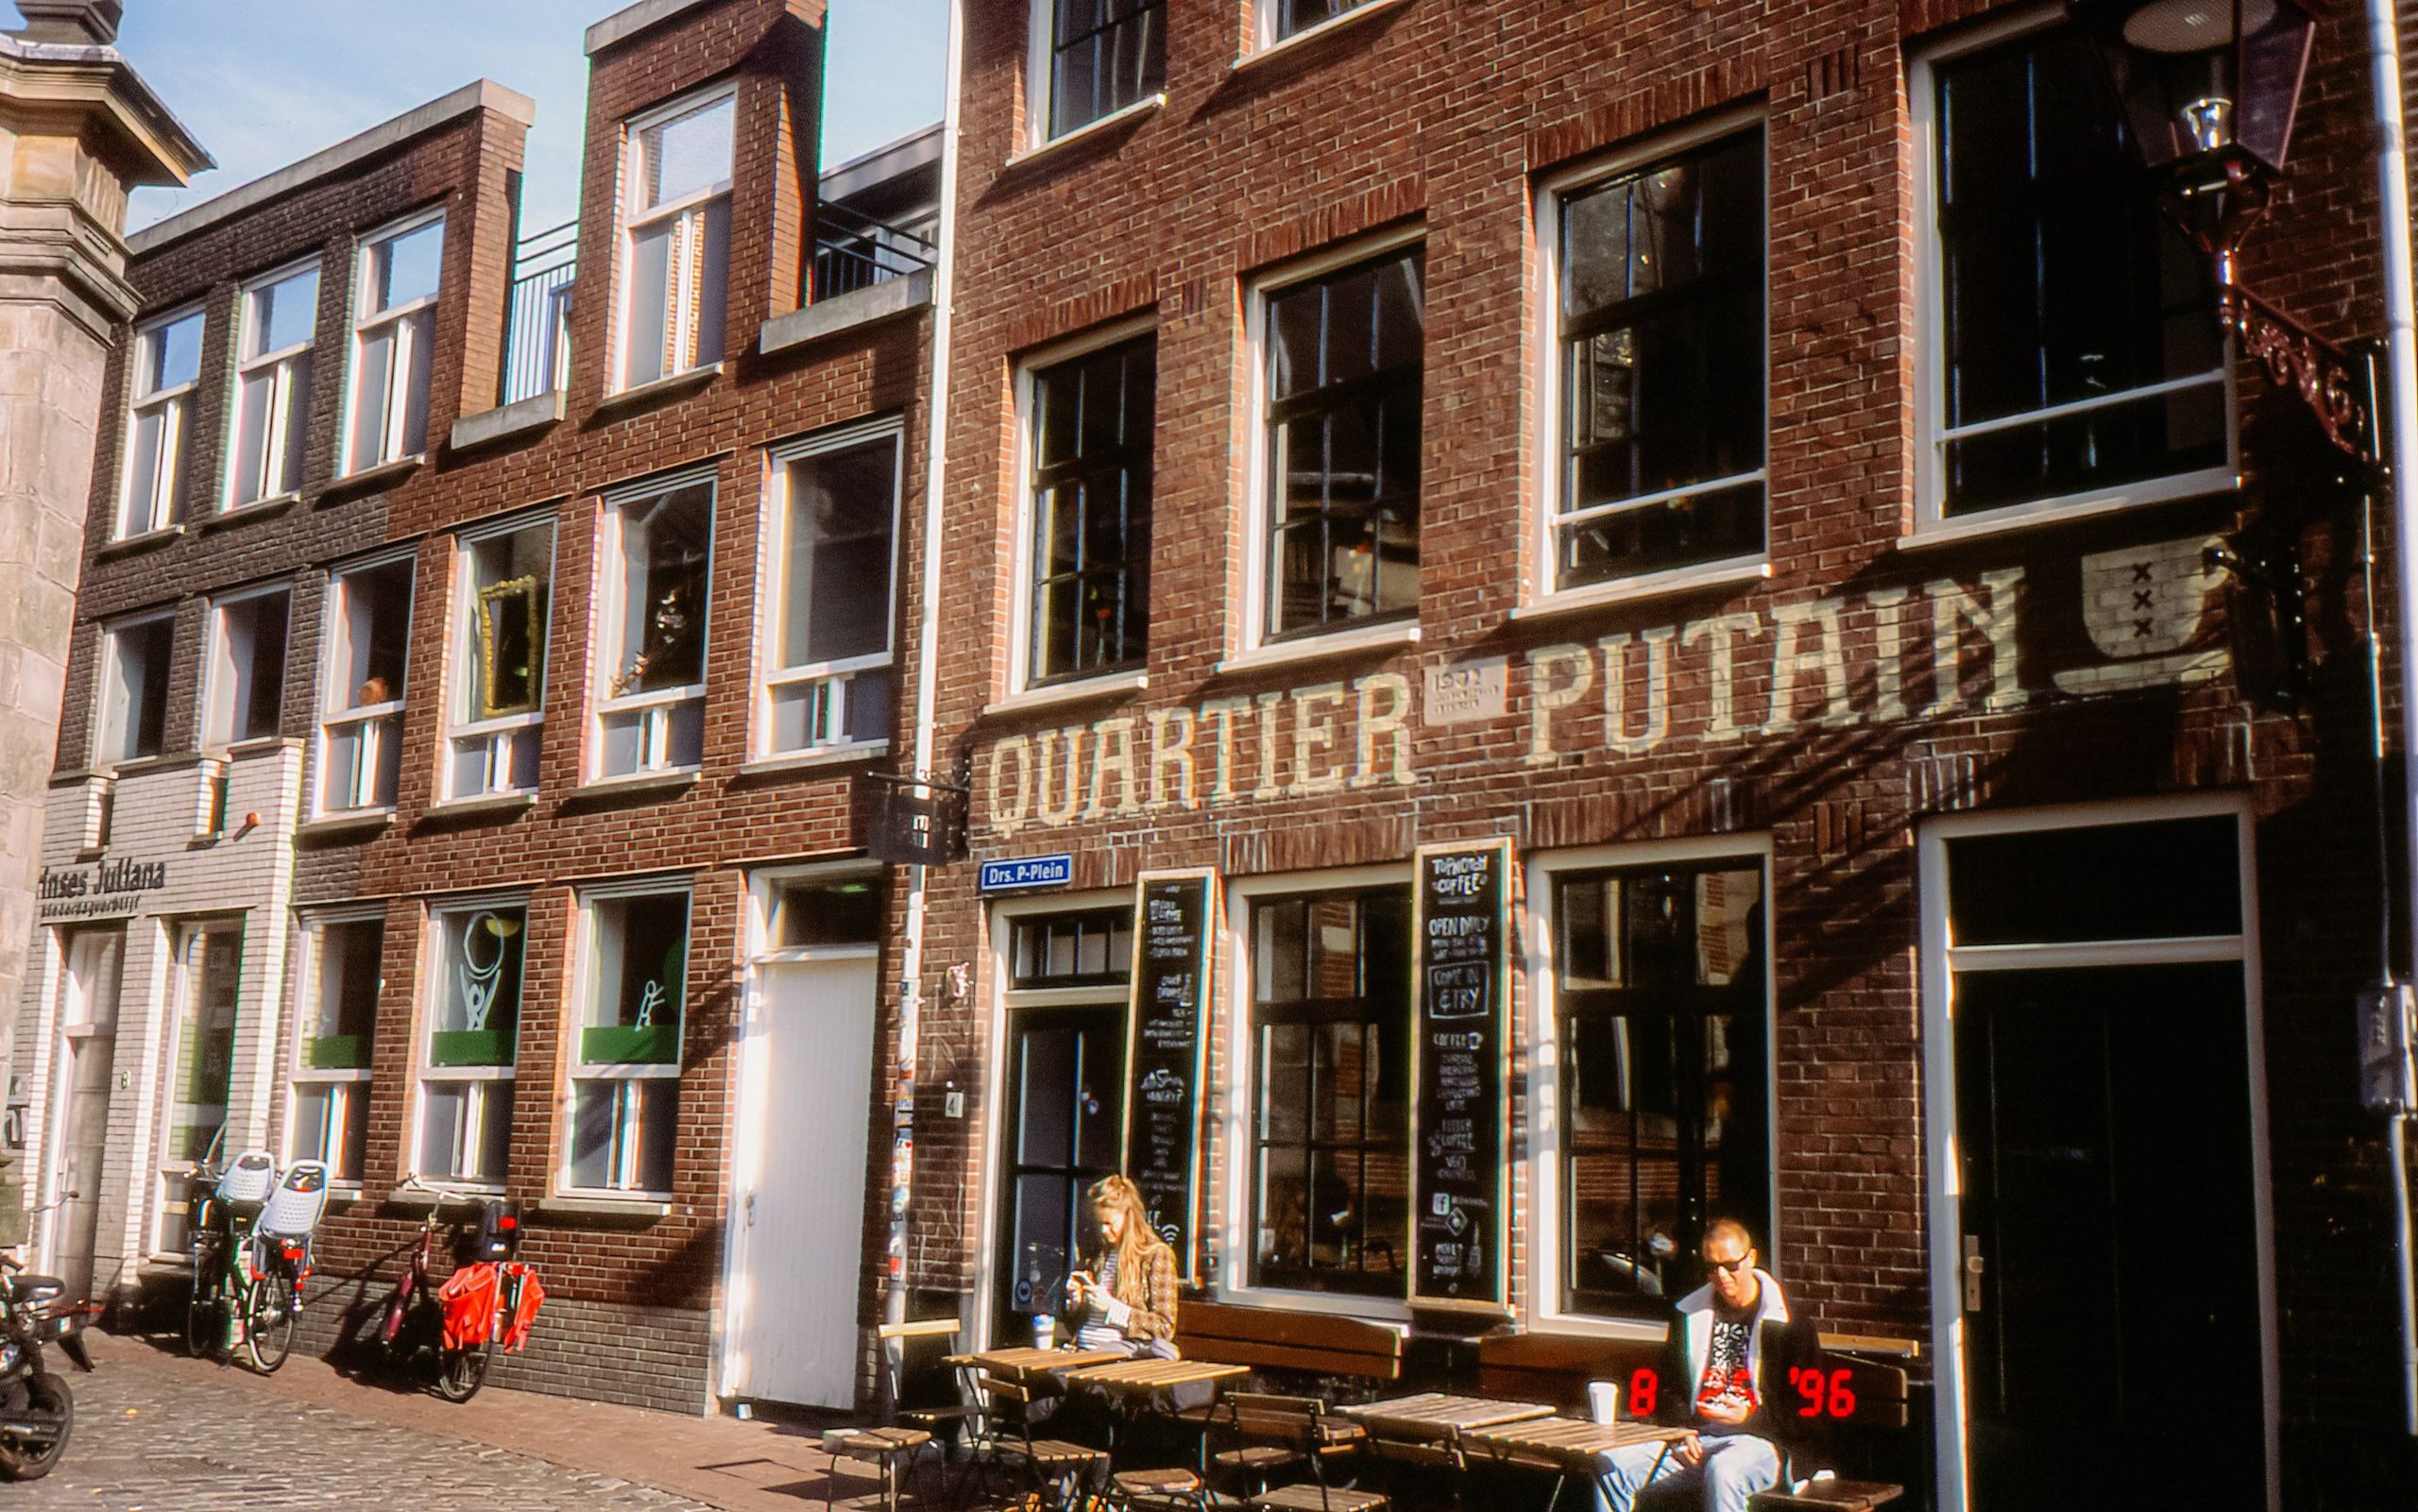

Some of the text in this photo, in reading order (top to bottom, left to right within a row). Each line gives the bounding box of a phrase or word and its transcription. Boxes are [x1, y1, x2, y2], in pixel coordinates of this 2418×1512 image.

[989, 566, 2028, 839] QUARTIER PUTAIN
[93, 857, 165, 895] Juliana
[989, 861, 1064, 884] Drs. P-Plein
[947, 1097, 956, 1113] 4
